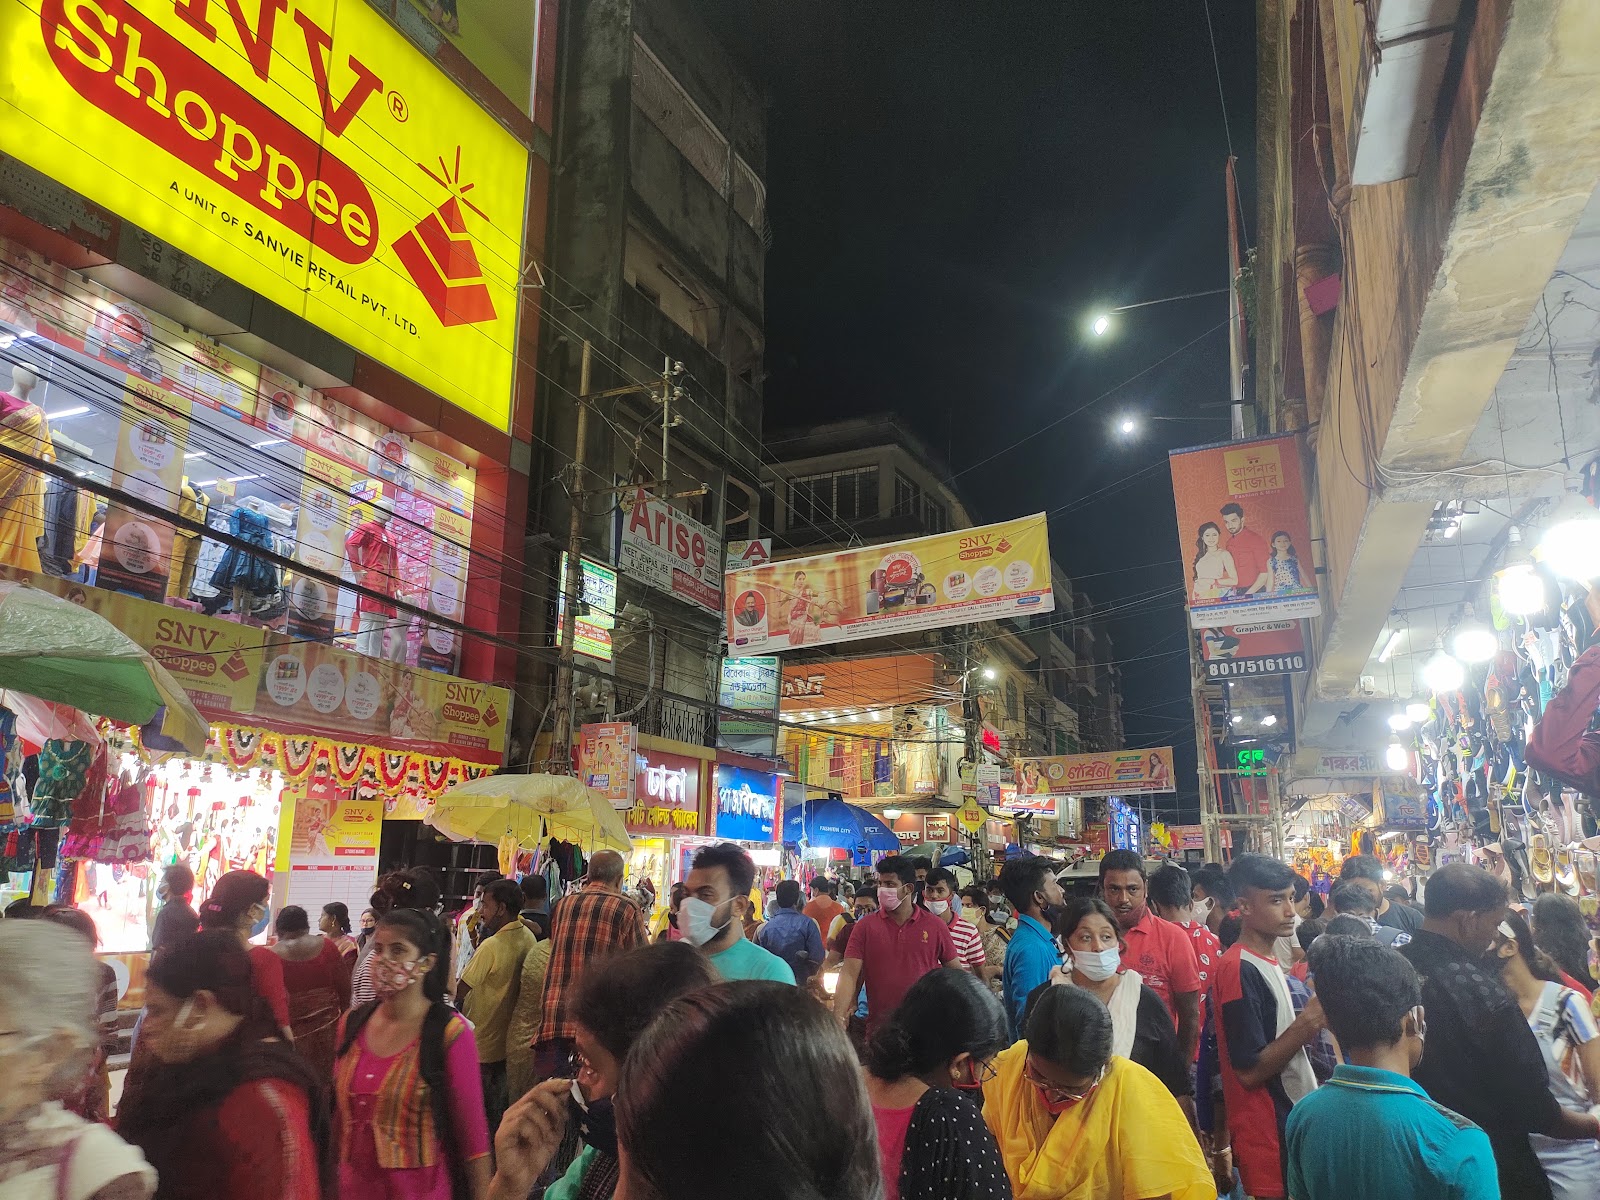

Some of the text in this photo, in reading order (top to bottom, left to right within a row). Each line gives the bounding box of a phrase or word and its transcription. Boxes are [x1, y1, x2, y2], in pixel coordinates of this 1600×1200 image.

[174, 0, 384, 138] NV
[54, 0, 371, 247] Shoppee
[169, 181, 422, 340] A UNIT OF SANVIE RETAIL PVT. LTD.
[1231, 462, 1277, 477] আপনার
[1231, 474, 1278, 491] বাজার
[629, 488, 706, 568] Arise
[959, 533, 991, 549] SNV
[959, 547, 993, 560] Shoppee
[155, 618, 220, 651] SNV
[1235, 624, 1265, 634] Graphic
[1273, 621, 1291, 630] Web
[152, 647, 215, 673] Shoppee
[1208, 655, 1304, 677] 8017516110
[445, 683, 481, 705] SNV
[443, 704, 479, 721] Shoppee
[646, 764, 688, 803] ঢাকা
[647, 805, 671, 827] গোল্ড
[671, 807, 698, 831] প্যালেস
